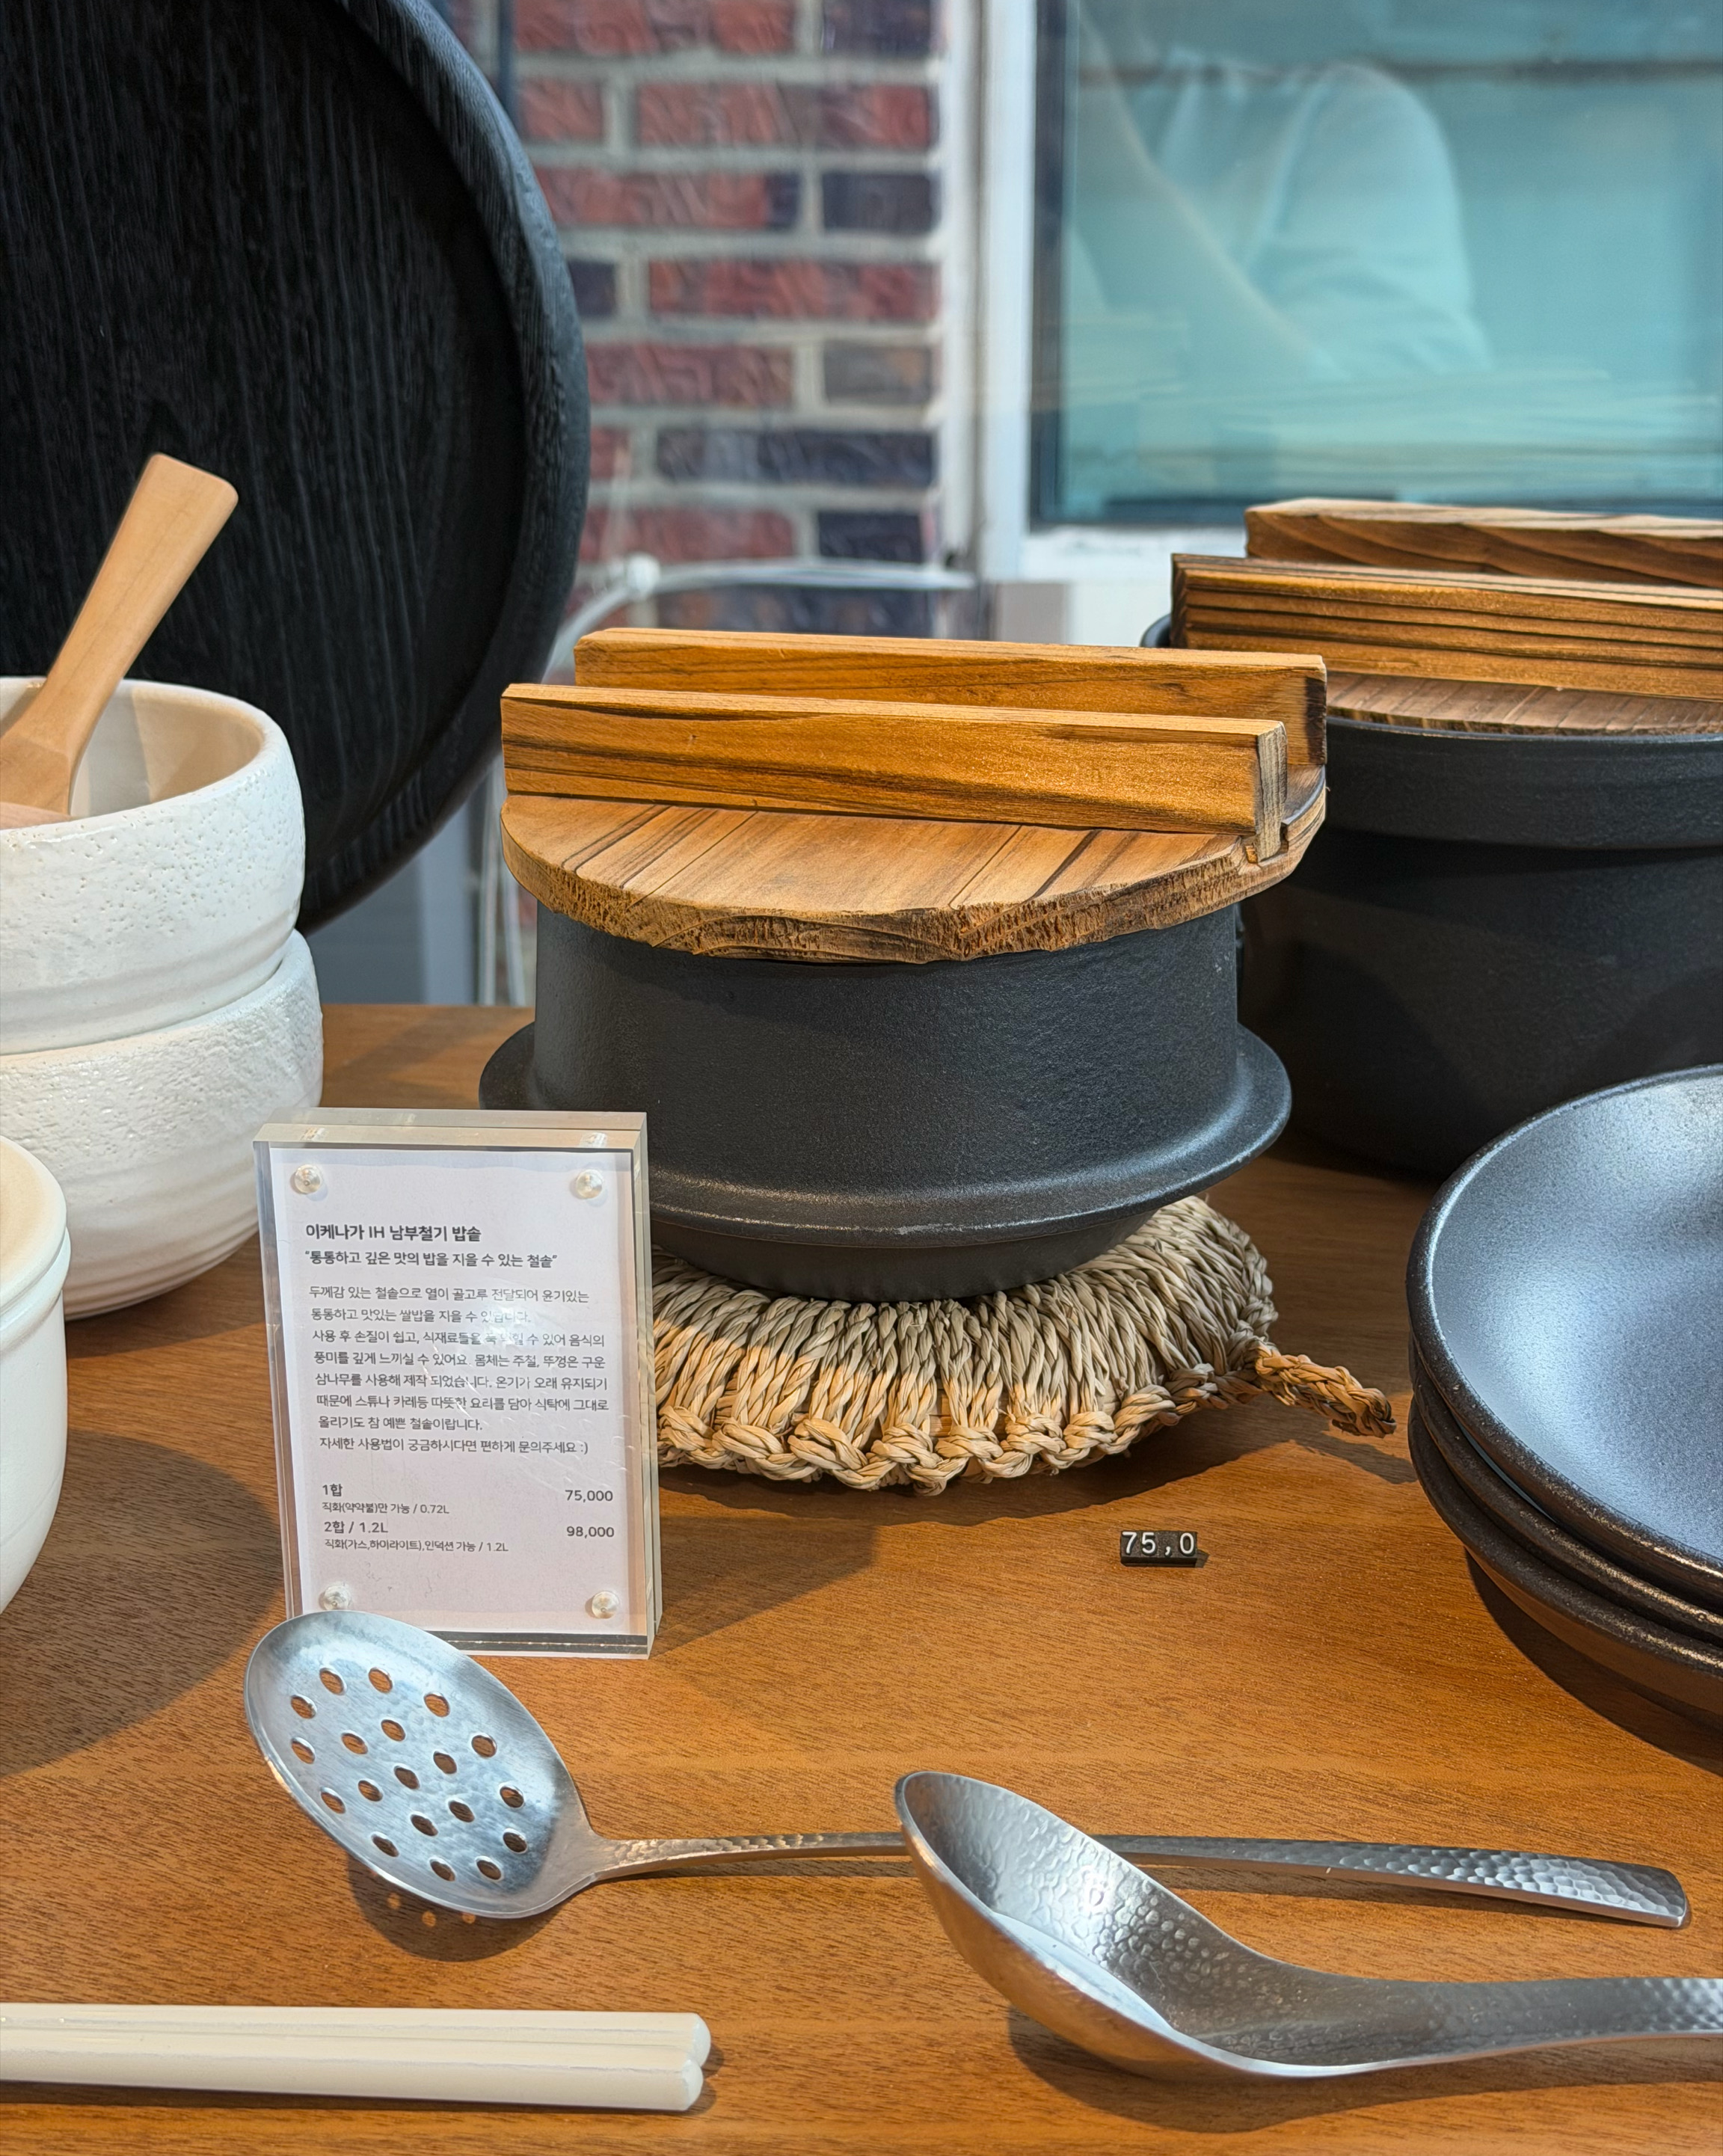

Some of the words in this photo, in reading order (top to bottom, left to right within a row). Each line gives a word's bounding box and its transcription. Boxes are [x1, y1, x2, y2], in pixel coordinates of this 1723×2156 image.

[306, 1223, 365, 1240] 이케나가
[369, 1226, 384, 1238] IH
[390, 1225, 447, 1241] 남부철기
[452, 1226, 482, 1241] 밥솥
[365, 1252, 390, 1265] 깊은
[394, 1252, 419, 1265] 맛의
[423, 1253, 449, 1266] 밥을
[452, 1253, 478, 1267] 지을
[481, 1253, 495, 1266] 수
[498, 1254, 523, 1267] 있는
[309, 1286, 345, 1298] 두께감
[348, 1287, 371, 1299] 있는
[375, 1287, 423, 1300] 철솥으로
[426, 1288, 449, 1300] 열이
[452, 1289, 488, 1300] 골고루
[492, 1289, 538, 1301] 전달되어
[542, 1290, 589, 1303] 윤기있는
[361, 1309, 396, 1321] 맛있는
[399, 1309, 435, 1322] 쌀밥을
[439, 1310, 462, 1322] 지을
[465, 1311, 477, 1322] 수
[313, 1330, 337, 1342] 사용
[340, 1330, 351, 1342] 후
[354, 1330, 389, 1343] 손질이
[393, 1331, 420, 1344] 쉽고,
[423, 1332, 481, 1345] 식재료들을
[527, 1333, 538, 1345] 수
[543, 1334, 565, 1345] 있어
[568, 1334, 604, 1347] 음식의
[314, 1351, 349, 1364] 풍미를
[353, 1352, 375, 1365] 깊게
[379, 1353, 414, 1365] 느끼실
[417, 1354, 429, 1365] 수
[433, 1354, 471, 1366] 있어요.
[475, 1354, 510, 1366] 몸체는
[513, 1355, 539, 1368] 주철,
[544, 1356, 579, 1368] 뚜껑은
[582, 1357, 605, 1369] 구운
[316, 1373, 362, 1386] 삼나무를
[366, 1374, 401, 1386] 사용해
[403, 1375, 428, 1387] 제작
[431, 1375, 492, 1388] 되었습니다.
[496, 1376, 530, 1389] 온기가
[534, 1377, 557, 1389] 오래
[561, 1378, 606, 1390] 유지되기
[317, 1395, 351, 1407] 때문에
[355, 1395, 390, 1407] 스튜나
[393, 1395, 429, 1409] 카레등
[431, 1396, 467, 1409] 따뜻한
[470, 1398, 505, 1410] 요리를
[509, 1398, 532, 1410] 담아
[535, 1398, 570, 1411] 식탁에
[574, 1400, 609, 1411] 그대로
[319, 1416, 365, 1428] 올리기도
[368, 1417, 380, 1428] 참
[383, 1417, 406, 1429] 예쁜
[410, 1418, 482, 1431] 철솥이랍니다.
[320, 1437, 354, 1449] 자세한
[357, 1437, 404, 1451] 사용법이
[408, 1439, 476, 1452] 궁금하시다면
[480, 1440, 515, 1453] 편하게
[518, 1441, 577, 1454] 문의주세요
[322, 1484, 343, 1496] 1합
[565, 1490, 613, 1502] 75,000
[390, 1504, 410, 1514] 가능
[413, 1504, 417, 1514] /
[420, 1505, 449, 1514] 0.72L
[325, 1520, 345, 1534] 2합
[348, 1521, 354, 1534] /
[359, 1522, 388, 1533] 1.2L
[567, 1526, 614, 1538] 98,000
[325, 1539, 453, 1551] 직화(가스,하이라이트),인덕션
[456, 1541, 476, 1552] 가능
[479, 1542, 483, 1552] /
[487, 1543, 509, 1551] 1.2L
[1122, 1532, 1194, 1555] 75,0
